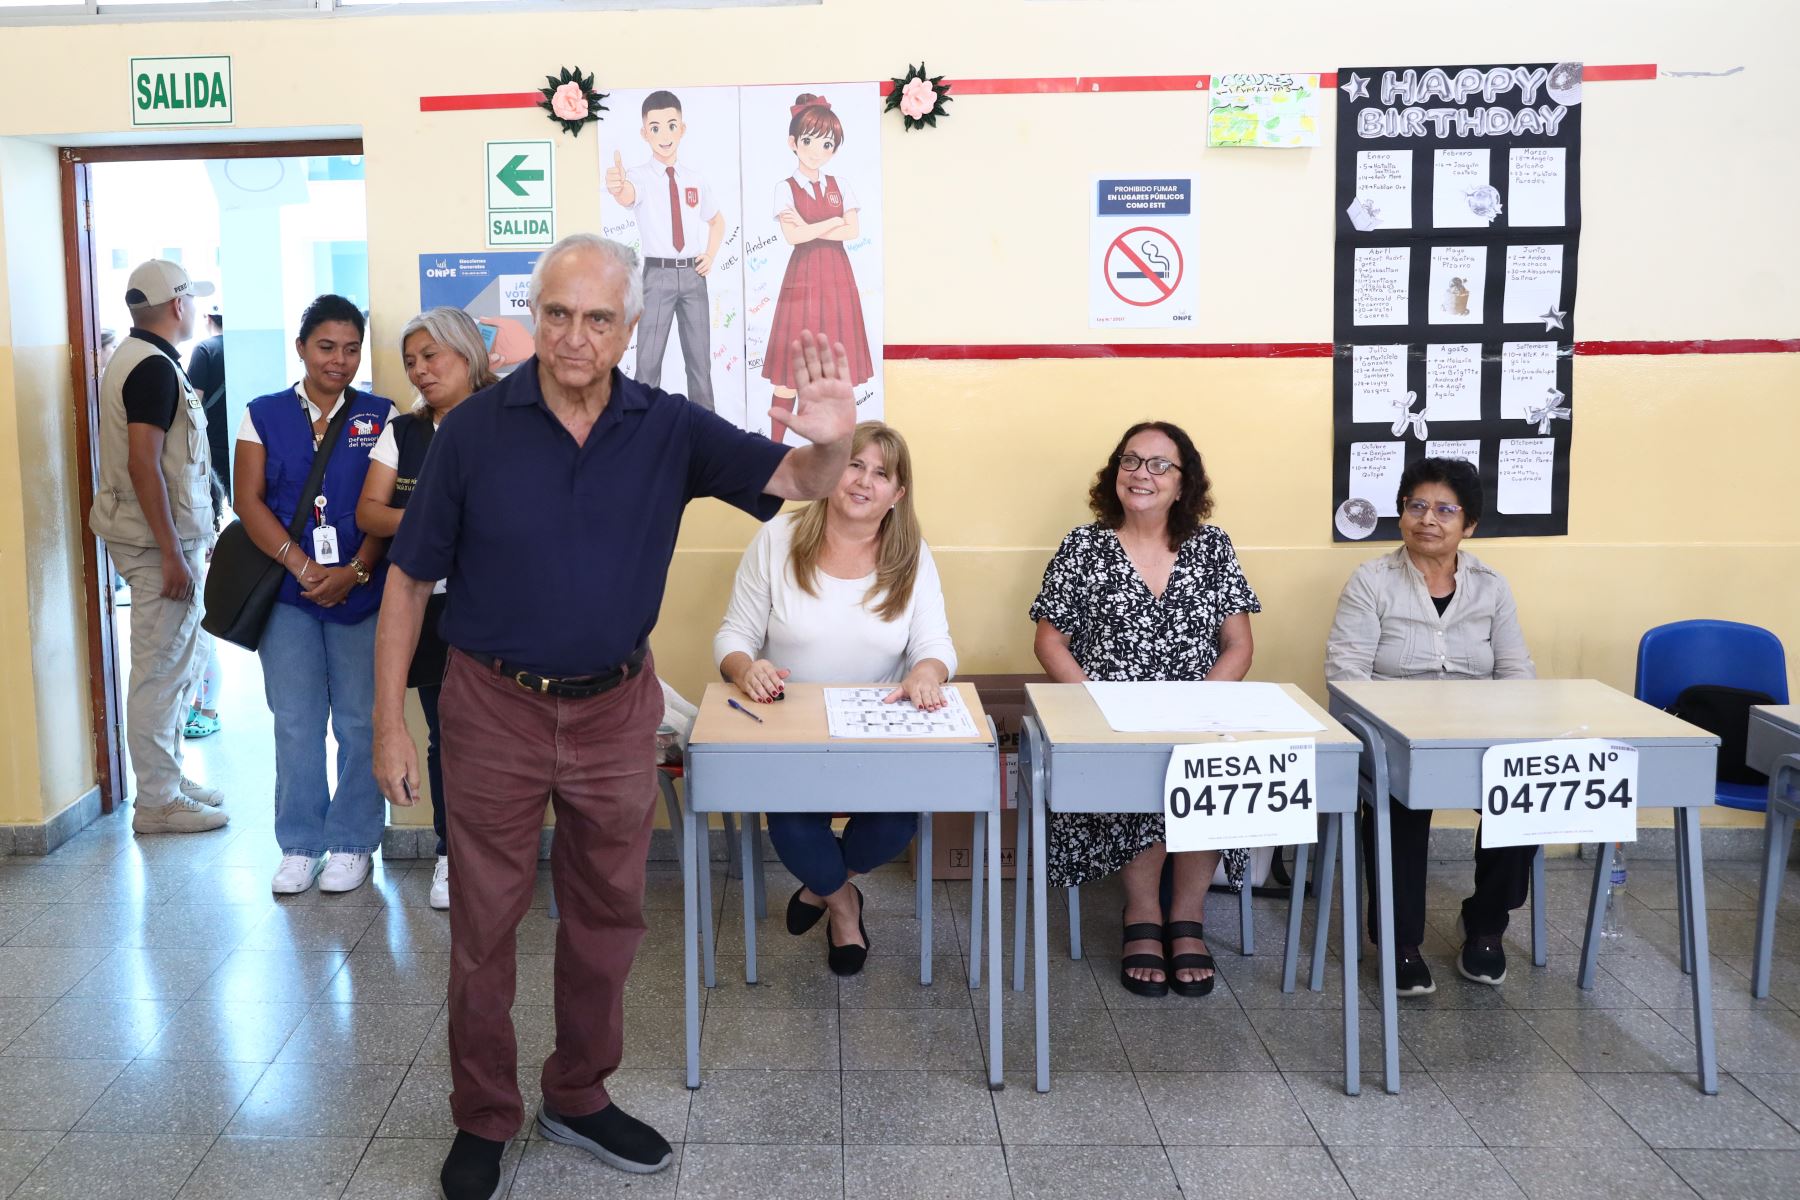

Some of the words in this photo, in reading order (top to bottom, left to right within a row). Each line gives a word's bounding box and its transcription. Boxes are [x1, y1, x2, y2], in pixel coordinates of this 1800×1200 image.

[137, 71, 227, 110] SALIDA
[1380, 66, 1548, 106] HAPPY
[1357, 105, 1568, 139] BIRTHDAY
[1367, 152, 1391, 160] Enero
[1524, 148, 1547, 156] Marzo
[1114, 185, 1152, 193] PROHIBIDO
[1153, 185, 1178, 193] FUMAR
[1118, 193, 1149, 201] LUGARES
[1150, 192, 1185, 201] PÚBLICOS
[493, 219, 550, 235] SALIDA
[745, 235, 778, 255] Andrea
[1446, 248, 1465, 256] Mayo
[426, 267, 457, 278] ONPE
[1184, 755, 1262, 780] MESA
[1503, 753, 1581, 778] MESA
[1169, 778, 1313, 819] 047754
[1487, 777, 1633, 816] 047754
